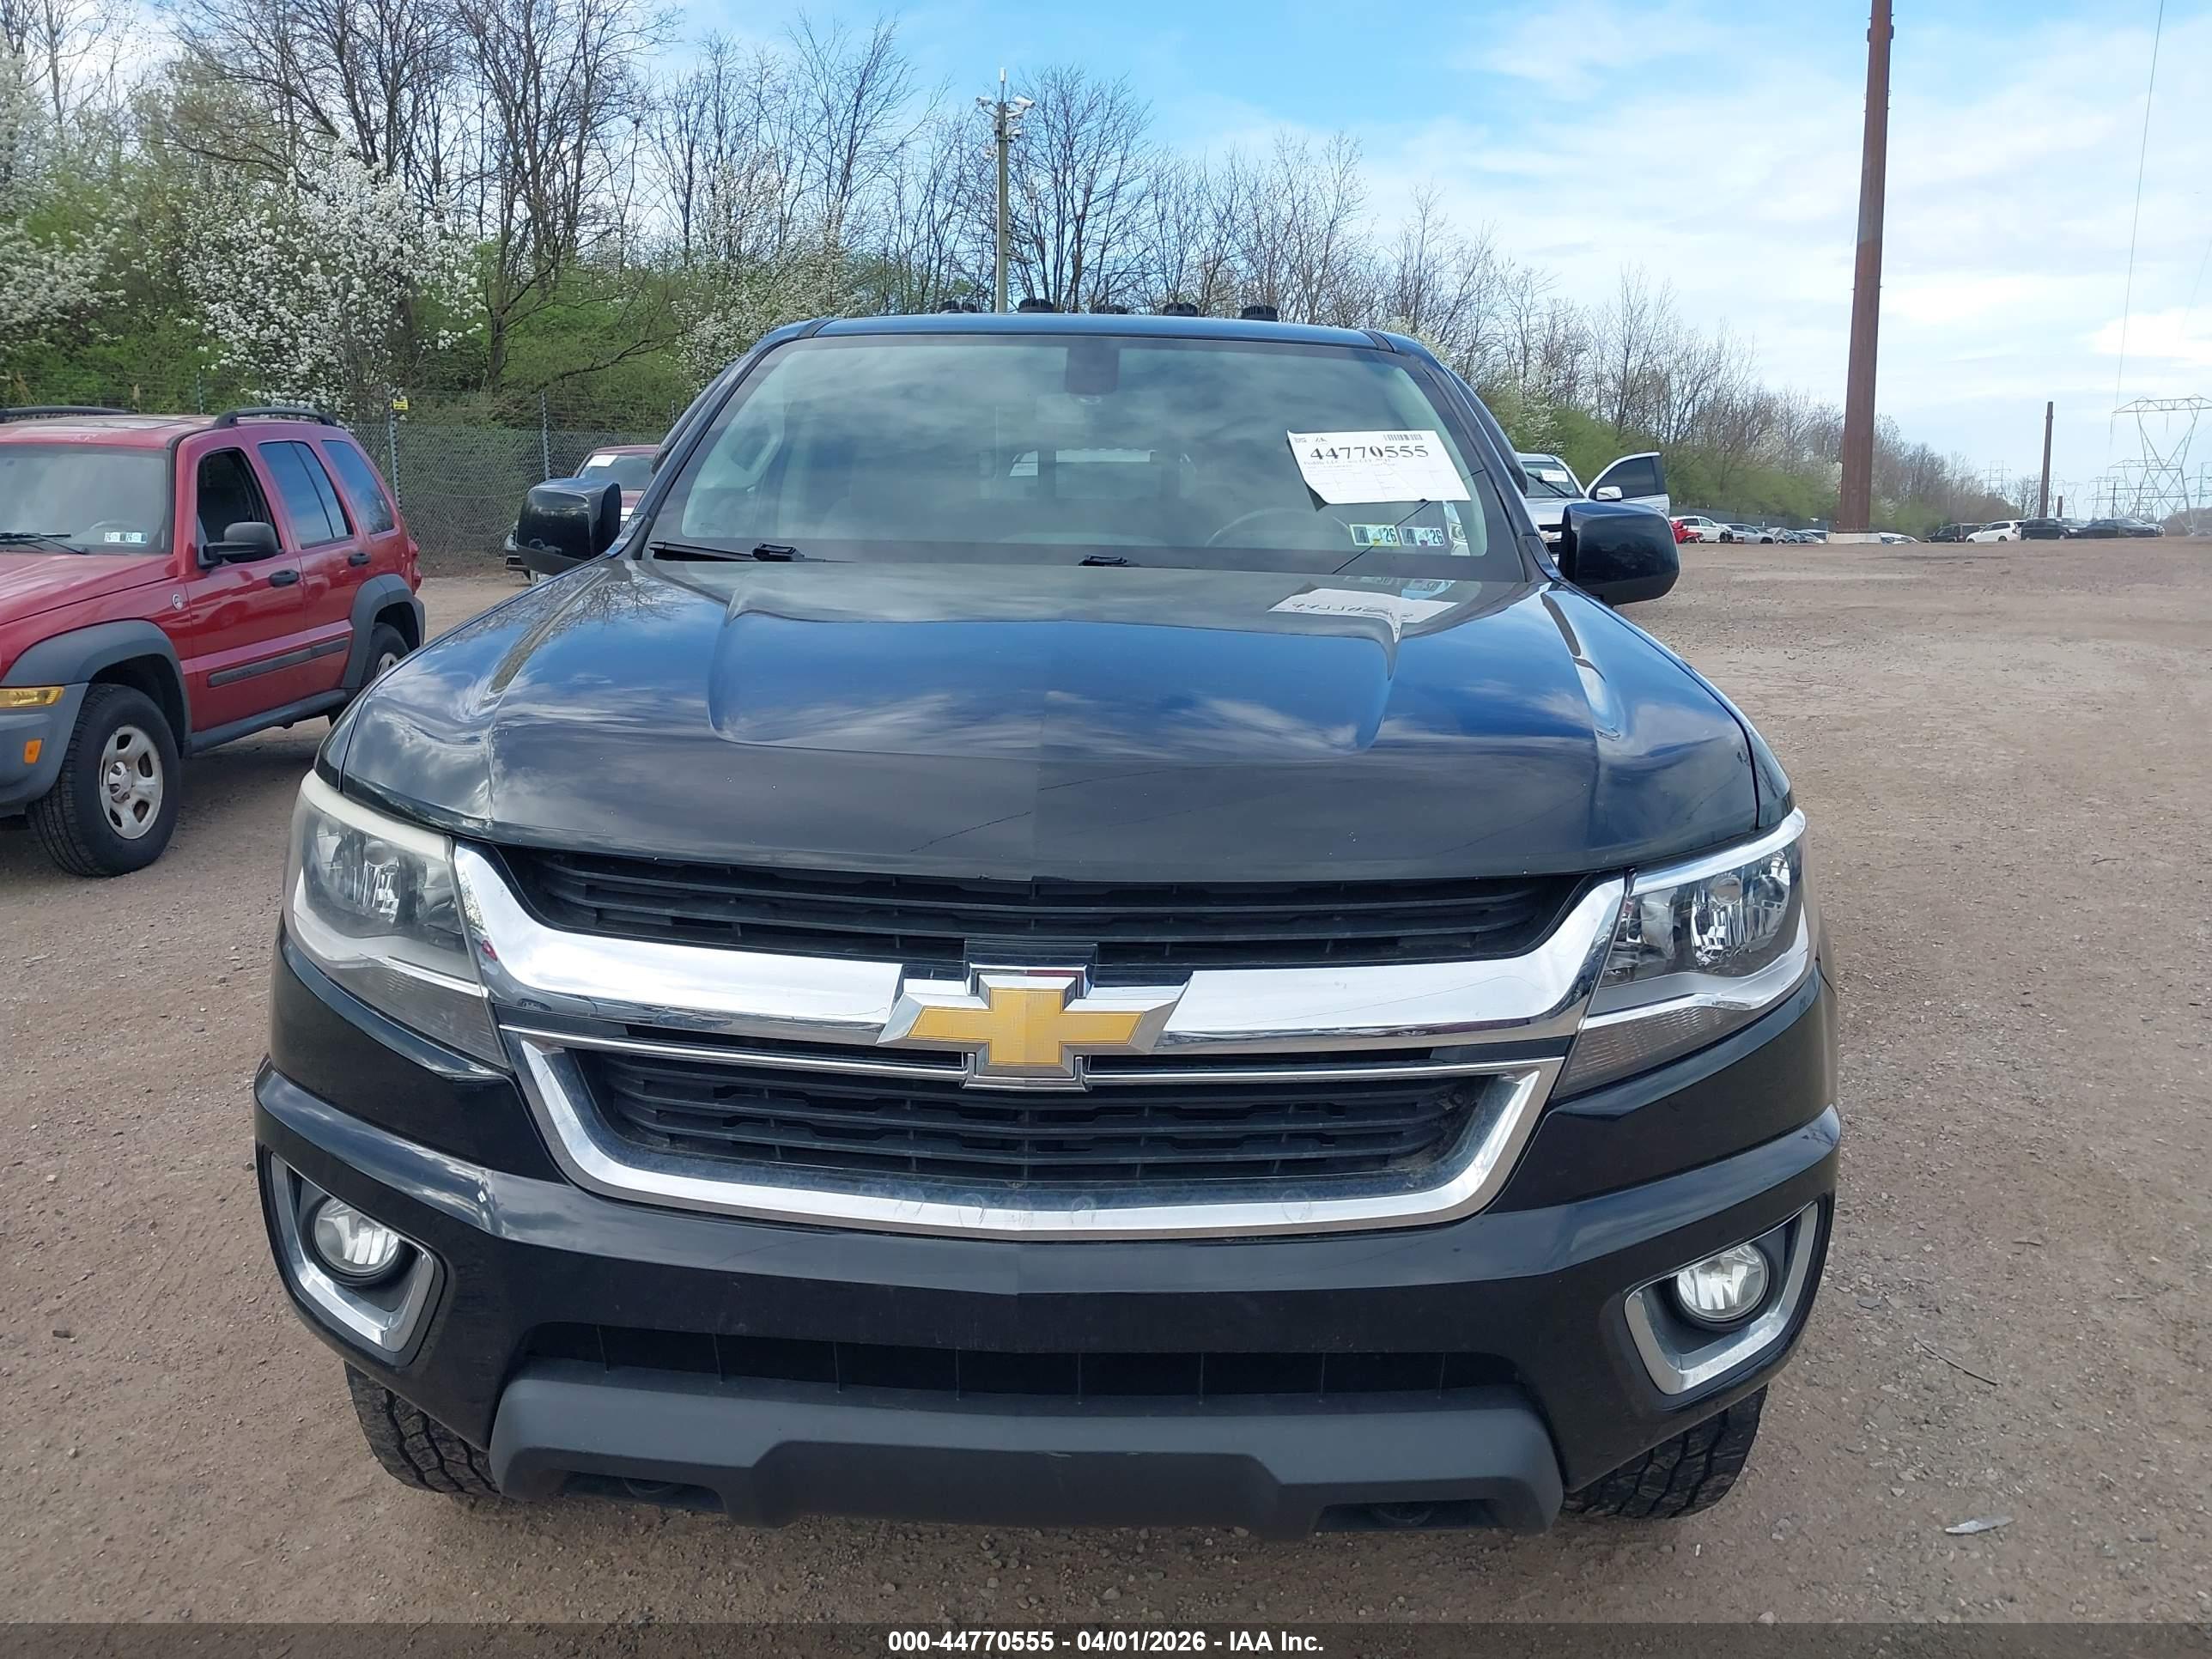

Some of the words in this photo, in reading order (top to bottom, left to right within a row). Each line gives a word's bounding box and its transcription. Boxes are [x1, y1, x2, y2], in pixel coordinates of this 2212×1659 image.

[1310, 445, 1429, 460] 44770555
[1382, 527, 1397, 543] 26
[1406, 528, 1415, 544] 4
[1430, 529, 1444, 544] 26
